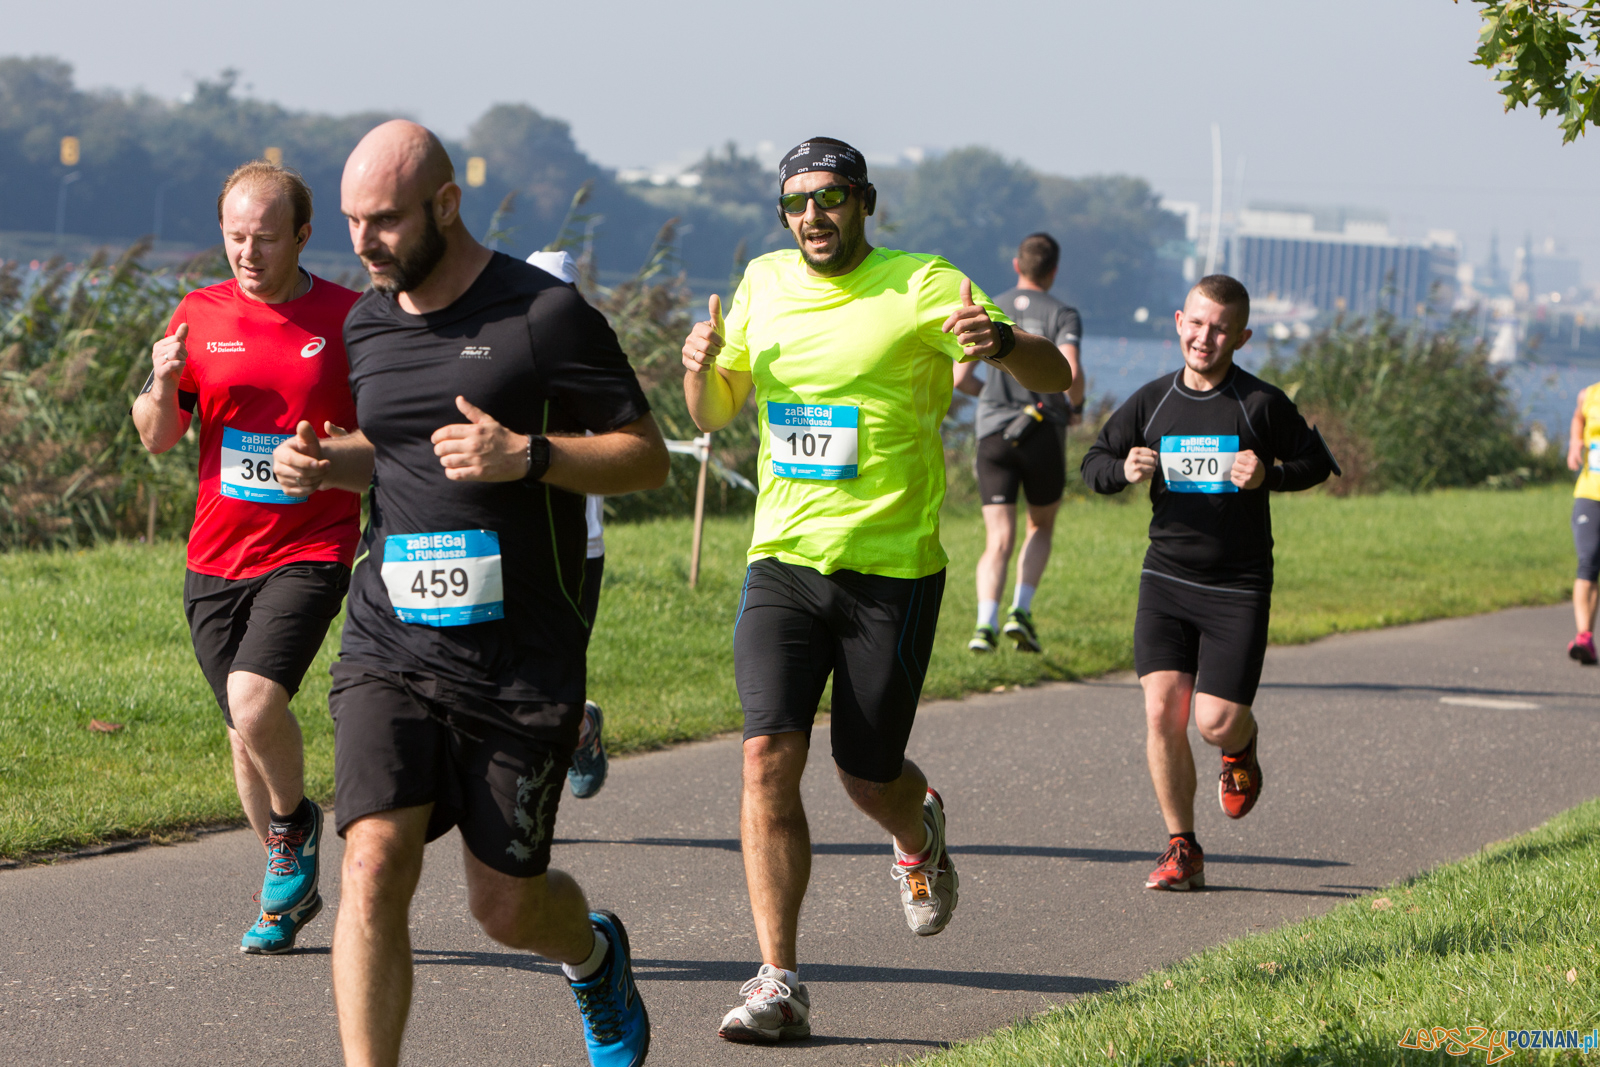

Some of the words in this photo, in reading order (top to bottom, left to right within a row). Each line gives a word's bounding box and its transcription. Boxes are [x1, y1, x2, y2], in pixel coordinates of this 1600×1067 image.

[789, 151, 810, 161] move
[206, 341, 218, 353] 13
[784, 407, 832, 420] zaBIEGaj
[792, 418, 832, 426] FUNdusze
[786, 432, 833, 458] 107
[1180, 437, 1220, 447] zaBIEGaj
[241, 458, 279, 483] 36
[1181, 458, 1219, 475] 370
[406, 534, 466, 550] zaBIEGaj
[406, 552, 414, 561] o
[414, 548, 467, 560] FUNdusze
[411, 567, 469, 599] 459
